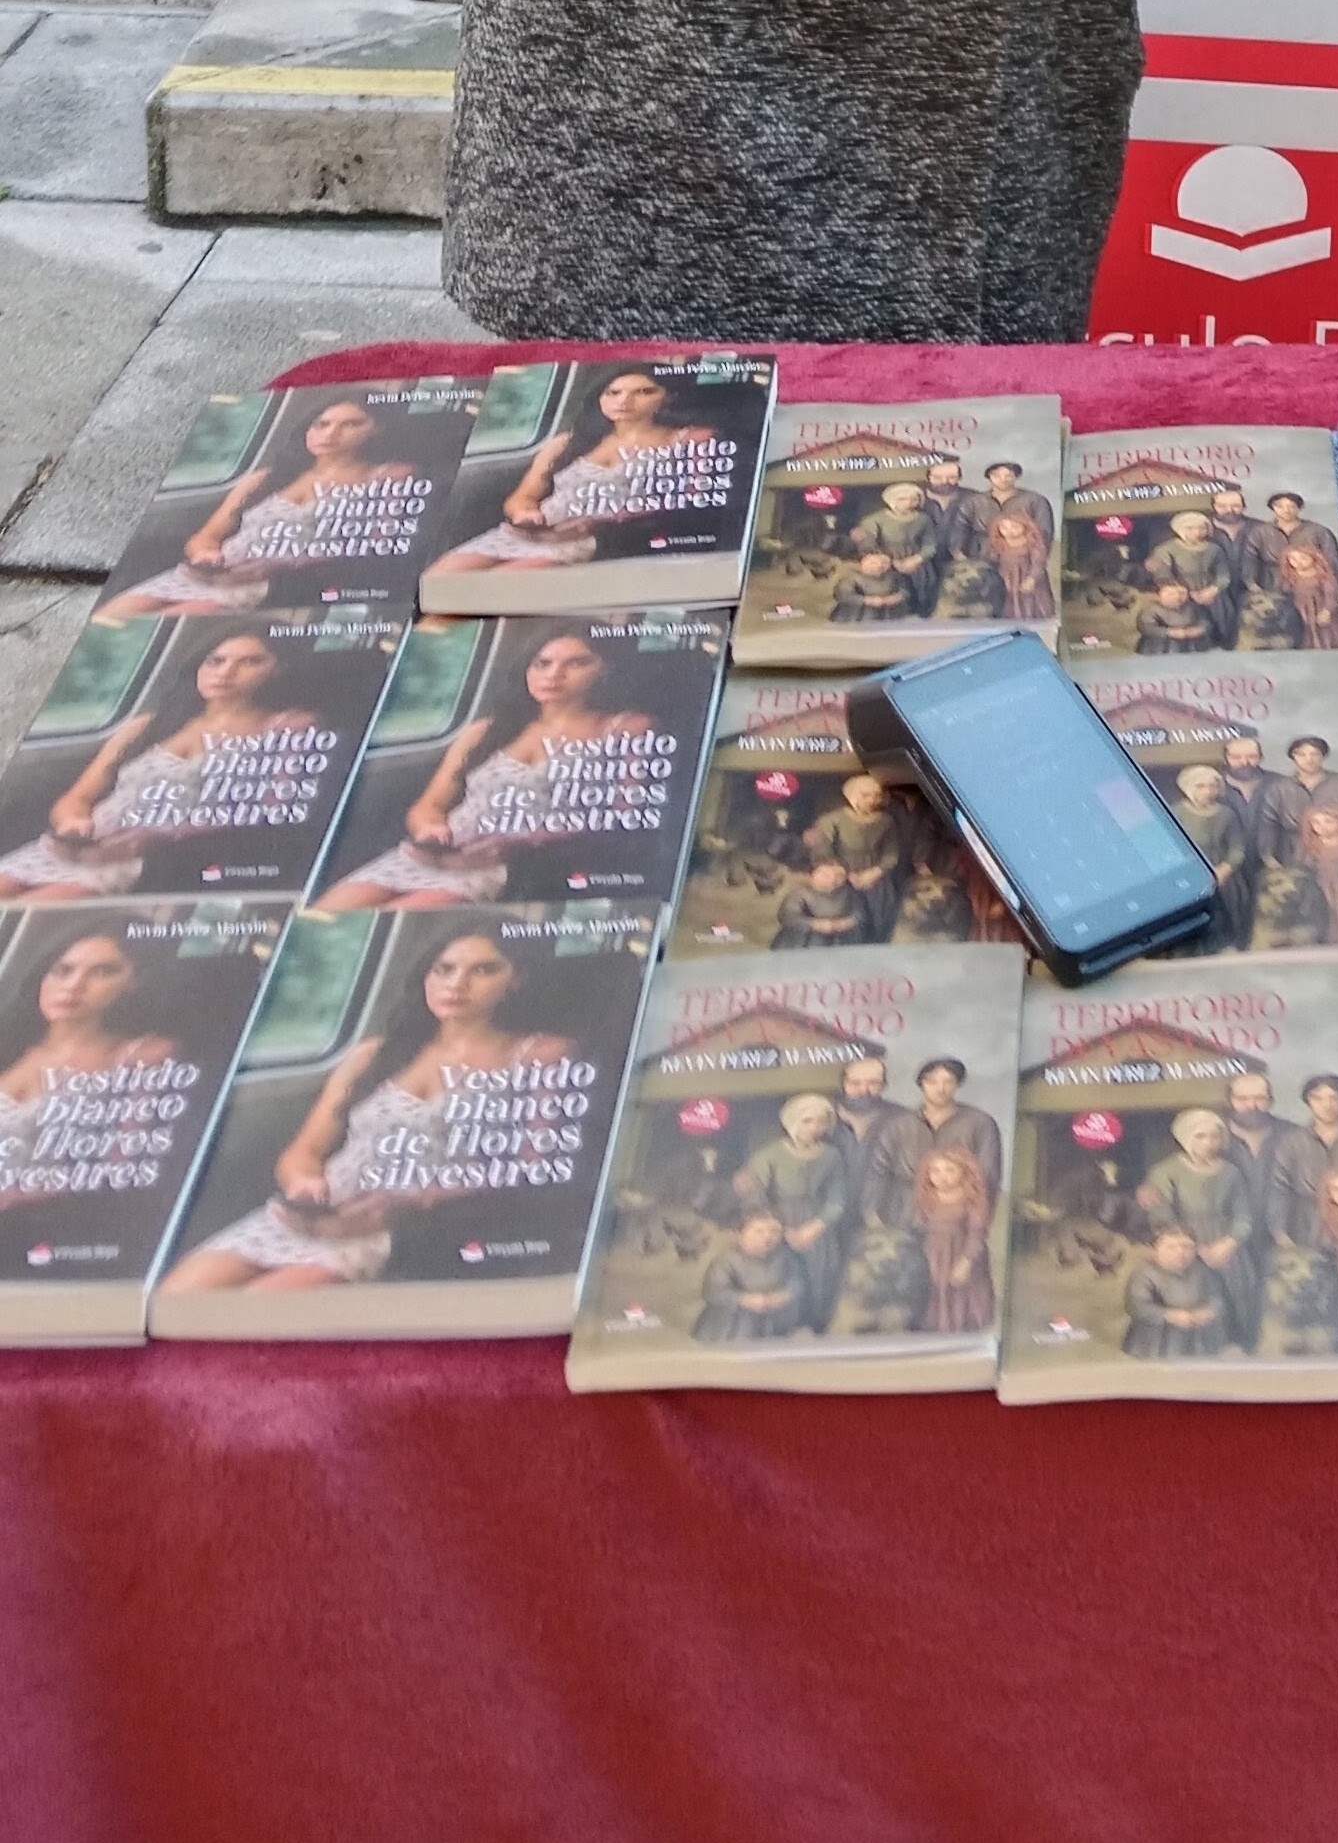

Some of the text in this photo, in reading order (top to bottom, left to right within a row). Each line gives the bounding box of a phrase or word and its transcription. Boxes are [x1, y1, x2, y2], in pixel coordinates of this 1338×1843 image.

[619, 438, 737, 460] Vestido
[625, 457, 734, 477] blanco
[314, 476, 432, 499] Vestido
[314, 496, 425, 518] blanco
[567, 491, 727, 517] silvestres
[248, 536, 411, 559] silvestres
[203, 725, 337, 752] Vestido
[542, 730, 678, 756] Vestido
[202, 752, 328, 777] blanco
[548, 757, 672, 782] blanco
[122, 802, 308, 827] silvestres
[478, 806, 661, 834] silvestres
[41, 1058, 199, 1094] Vestido
[440, 1057, 596, 1091] Vestido
[37, 1094, 188, 1126] blanco
[444, 1092, 589, 1123] blanco
[358, 1156, 574, 1190] silvestres
